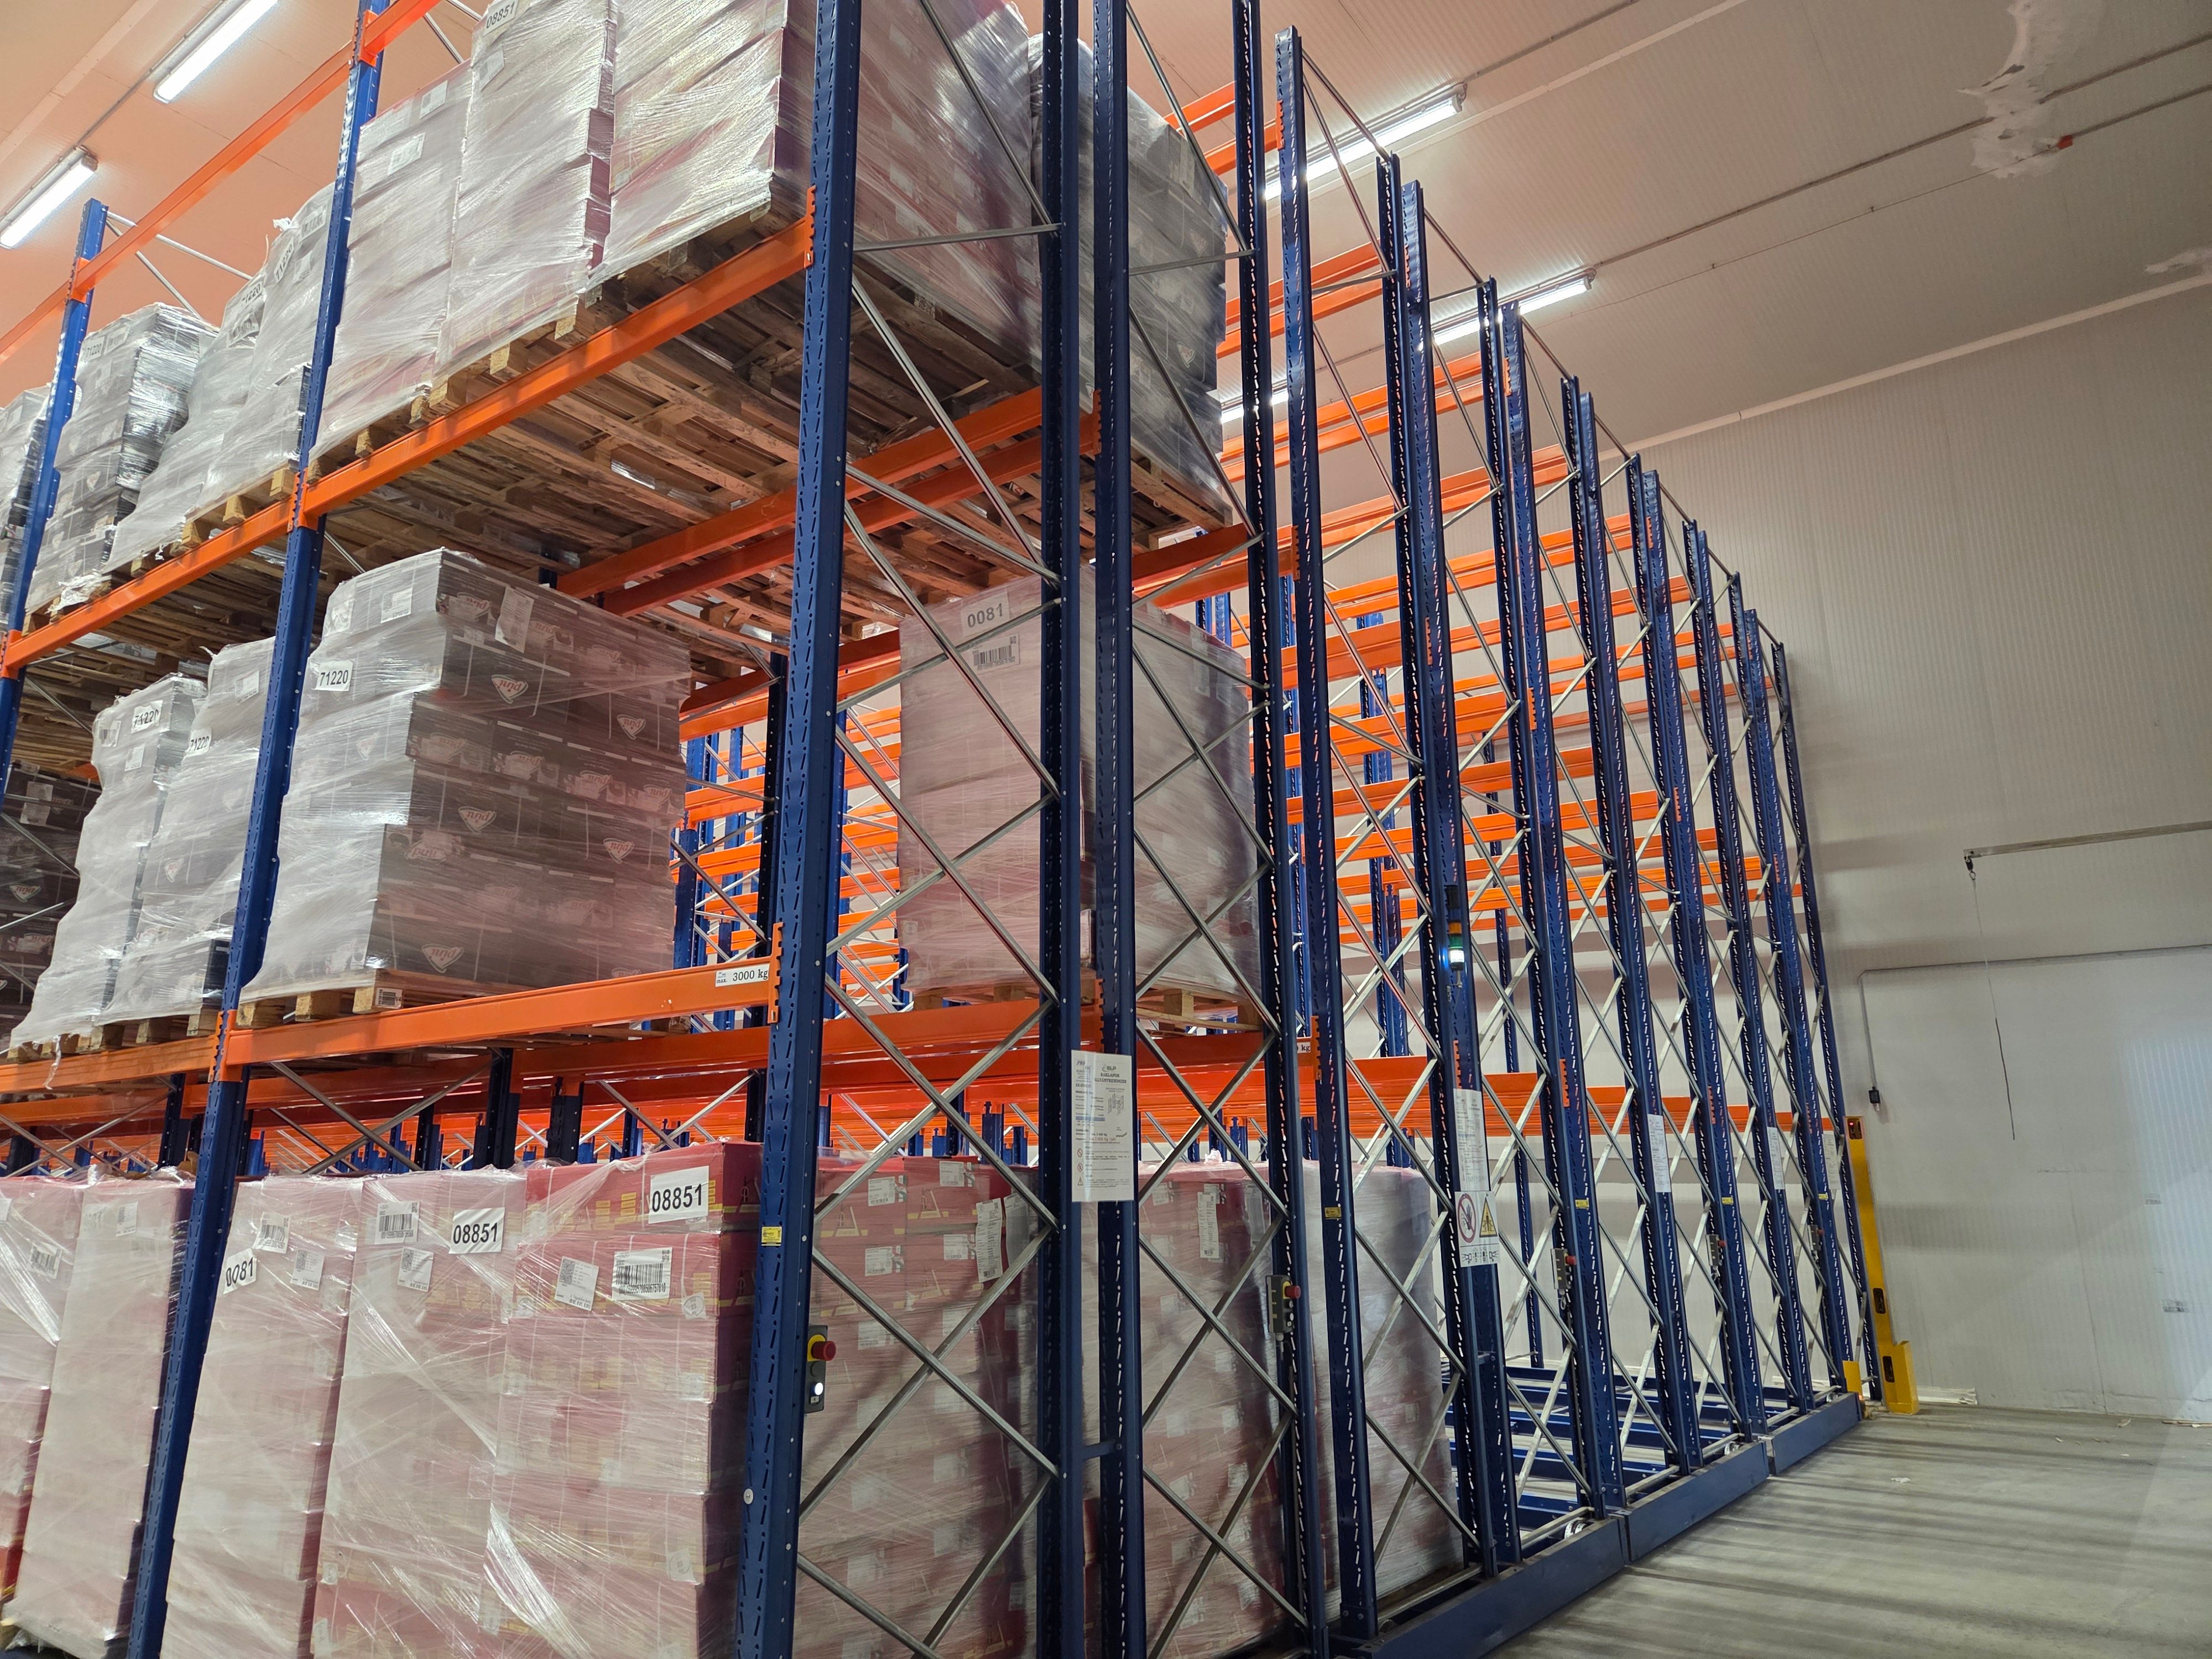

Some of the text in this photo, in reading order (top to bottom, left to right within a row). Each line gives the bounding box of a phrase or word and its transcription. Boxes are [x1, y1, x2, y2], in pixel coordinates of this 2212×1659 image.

[486, 1, 515, 28] 08851
[967, 603, 1003, 628] 0081
[320, 669, 349, 686] 71220
[134, 709, 159, 727] 71220
[189, 735, 210, 752] 71220
[733, 970, 755, 982] 3000
[758, 969, 768, 980] kg
[1301, 1044, 1310, 1052] kg
[651, 1183, 702, 1213] 08851
[453, 1222, 498, 1244] 08851
[226, 1256, 254, 1287] 0081
